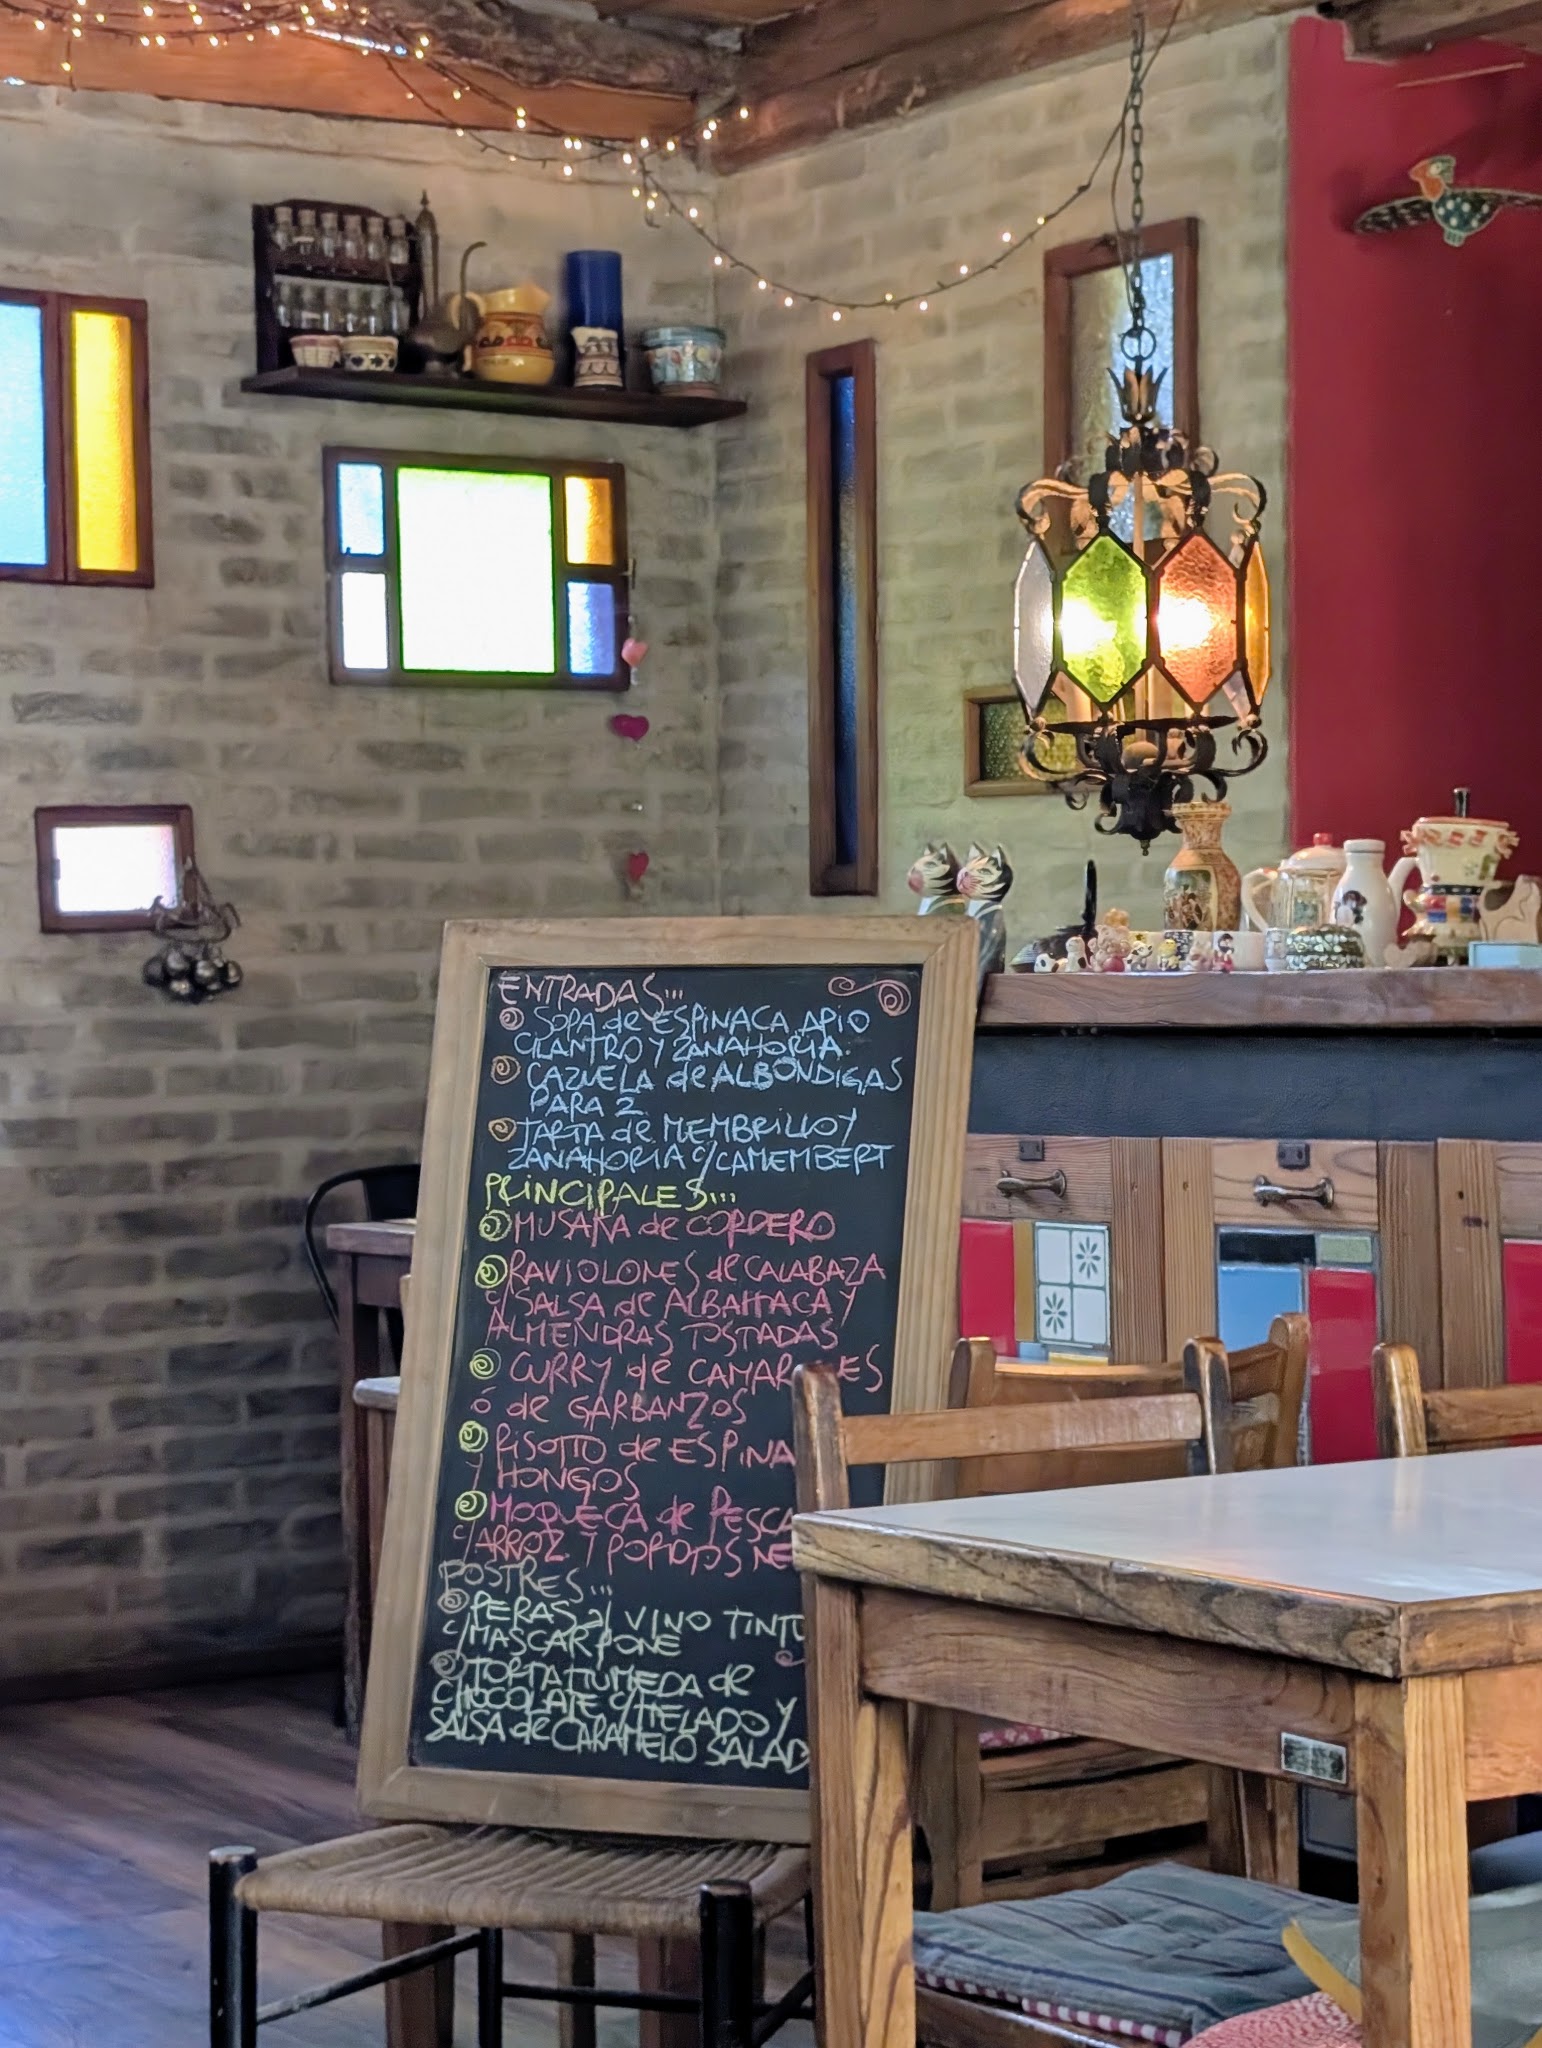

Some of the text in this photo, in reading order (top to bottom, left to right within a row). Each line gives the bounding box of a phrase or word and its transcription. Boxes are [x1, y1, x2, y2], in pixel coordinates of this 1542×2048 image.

[533, 1006, 596, 1040] SOPA
[602, 1008, 641, 1033] de
[514, 1032, 643, 1065] CILANTRO
[527, 1056, 903, 1096] CAZUELA de ALBONDIGAS
[530, 1086, 644, 1122] PARA 2
[517, 1117, 605, 1150] TARTA
[611, 1119, 652, 1143] de
[508, 1144, 686, 1176] ZANAHORIA
[514, 1209, 836, 1248] MUSAKA de CORDERO
[510, 1249, 886, 1297] RAVIOLONES de CALABAZA
[614, 1292, 656, 1317] de
[664, 1287, 832, 1319] ALBAHACA
[485, 1306, 838, 1357] ALMENDRAS TOSTADAS
[509, 1351, 611, 1396] CURRY
[626, 1353, 671, 1390] de
[506, 1391, 549, 1420] de
[568, 1387, 747, 1430] GARBANZOS
[496, 1422, 606, 1467] RISOTTO
[619, 1434, 661, 1461] de
[497, 1459, 640, 1506] HONGOS
[490, 1491, 649, 1534] MOQUECA
[656, 1495, 695, 1535] de
[607, 1531, 742, 1577] POROTOS
[470, 1591, 578, 1638] PERAS
[625, 1606, 711, 1639] VINO
[467, 1656, 562, 1695] TORTA
[708, 1664, 754, 1697] de
[432, 1679, 600, 1722] CHOCOLATE
[425, 1706, 506, 1745] SALSA
[510, 1717, 550, 1745] de
[552, 1713, 697, 1763] CARAMELO
